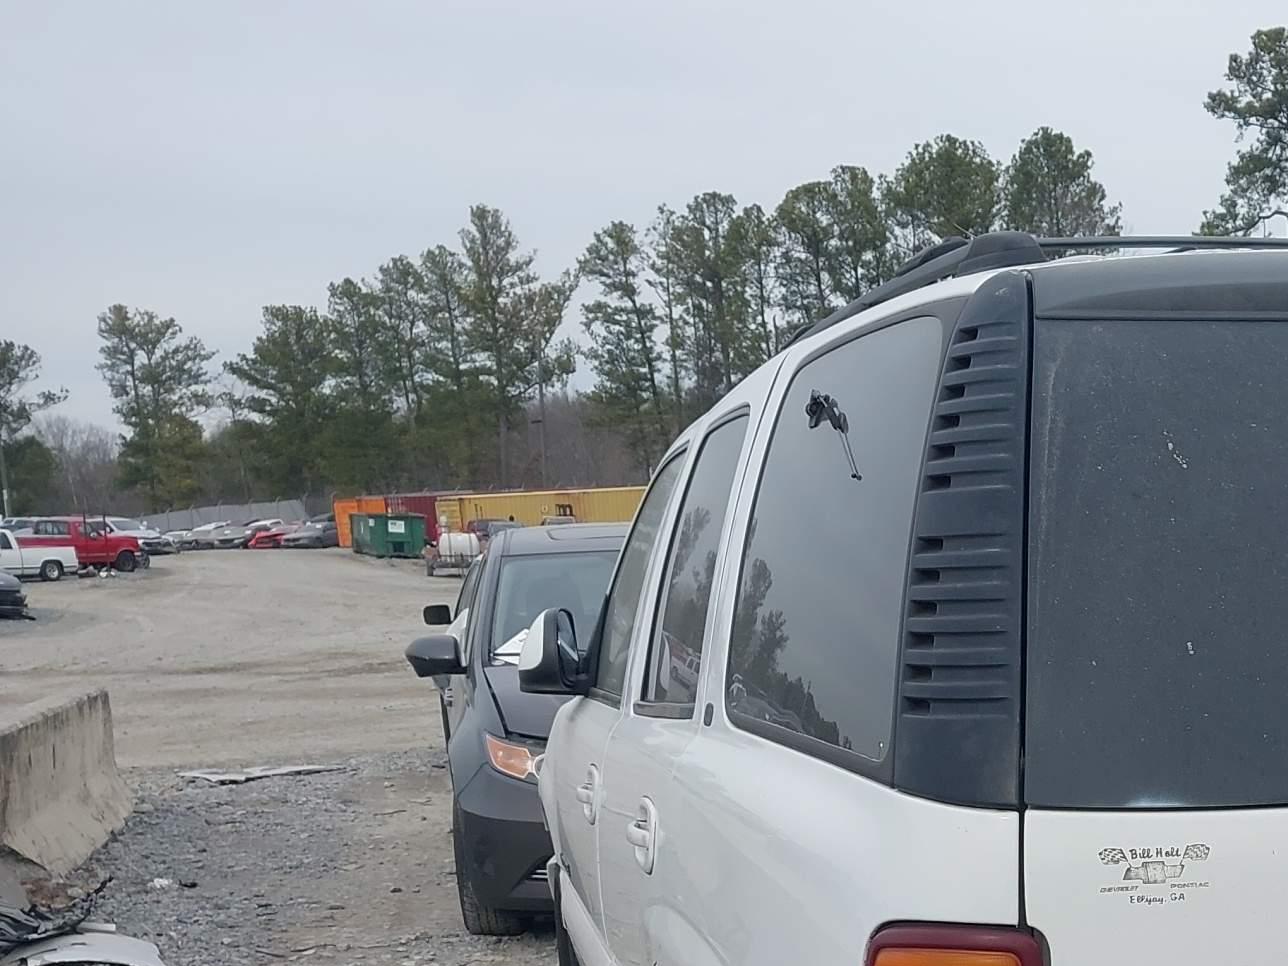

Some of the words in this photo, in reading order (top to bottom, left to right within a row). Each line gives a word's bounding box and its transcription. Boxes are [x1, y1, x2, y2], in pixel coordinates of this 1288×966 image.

[1129, 848, 1153, 860] Bill
[1170, 881, 1209, 889] PONTIAC
[1170, 892, 1185, 902] GA
